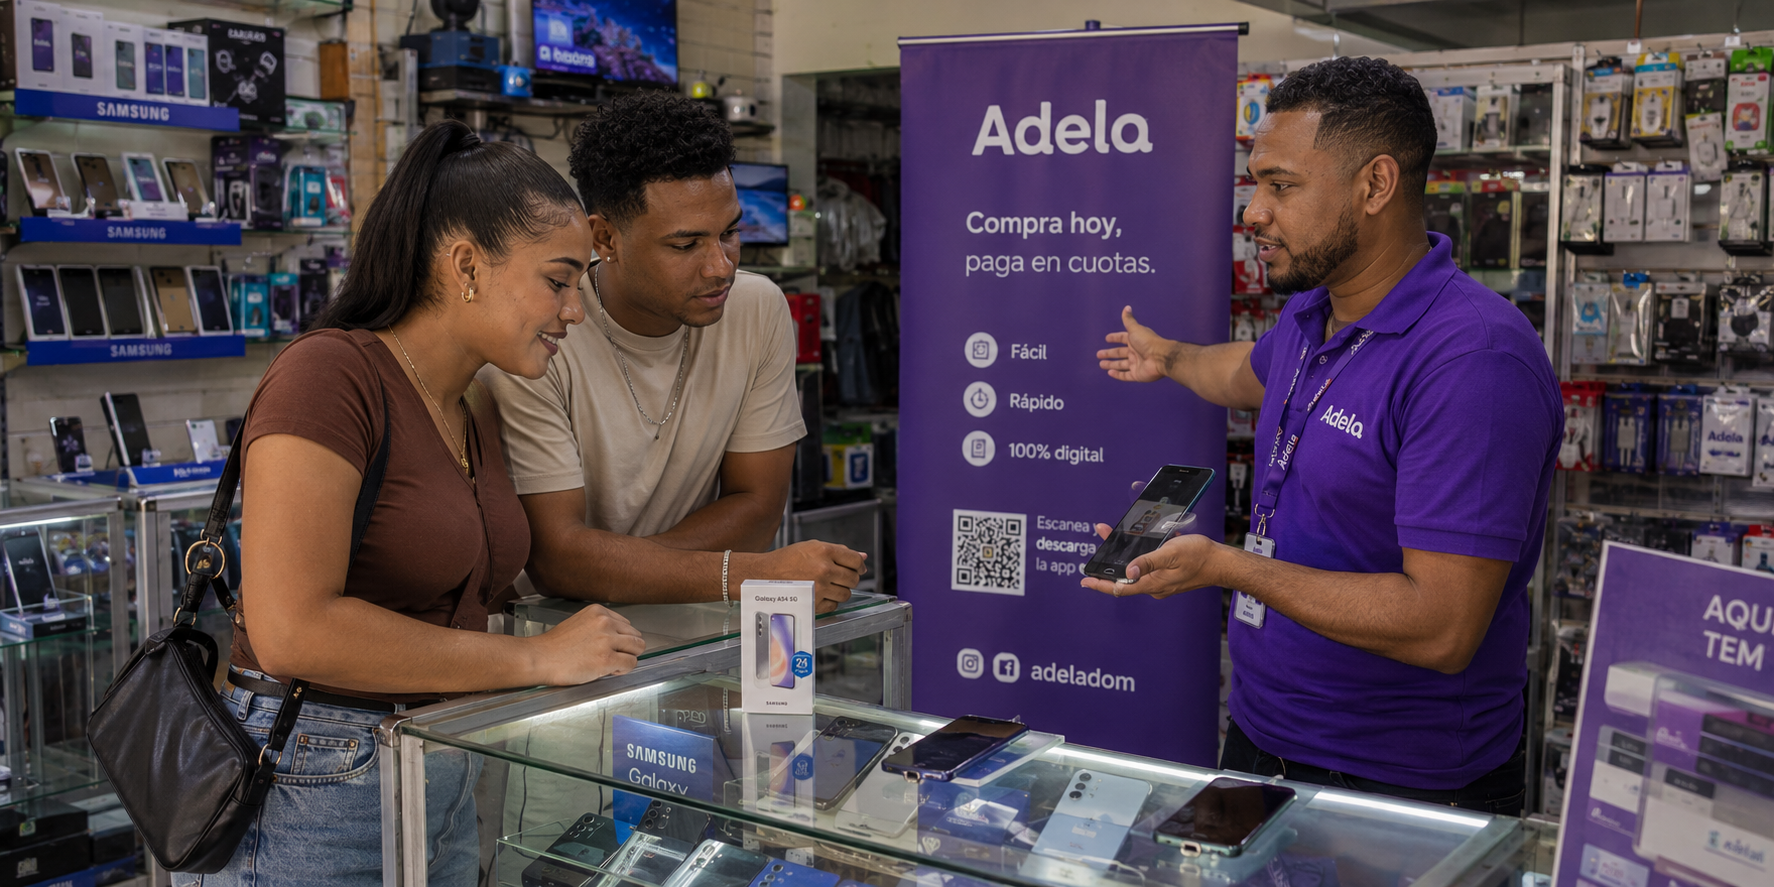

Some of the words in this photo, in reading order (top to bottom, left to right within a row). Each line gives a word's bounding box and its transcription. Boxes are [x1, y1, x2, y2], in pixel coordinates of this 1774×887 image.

[97, 101, 170, 121] SAMSUNG
[972, 99, 1153, 155] Adela
[107, 225, 167, 239] SAMSUNG
[966, 211, 1063, 239] Compra
[1070, 211, 1122, 240] hoy,
[966, 254, 1024, 278] paga
[1031, 255, 1060, 272] en
[1068, 252, 1156, 274] cuotas.
[110, 343, 172, 358] SAMSUNG
[1011, 343, 1047, 360] Fácil
[1009, 393, 1064, 412] Rápido
[1320, 405, 1363, 439] Adela
[1008, 442, 1051, 460] 100%
[1055, 445, 1104, 465] digital
[1037, 515, 1090, 532] Escanea
[1036, 536, 1097, 557] descarga
[1035, 557, 1047, 571] la
[1050, 561, 1076, 576] app
[1702, 594, 1774, 636] AQU
[1703, 629, 1765, 671] TEM
[1030, 662, 1136, 692] adeladom
[626, 743, 697, 774] SAMSUNG
[628, 767, 689, 796] Galaxy
